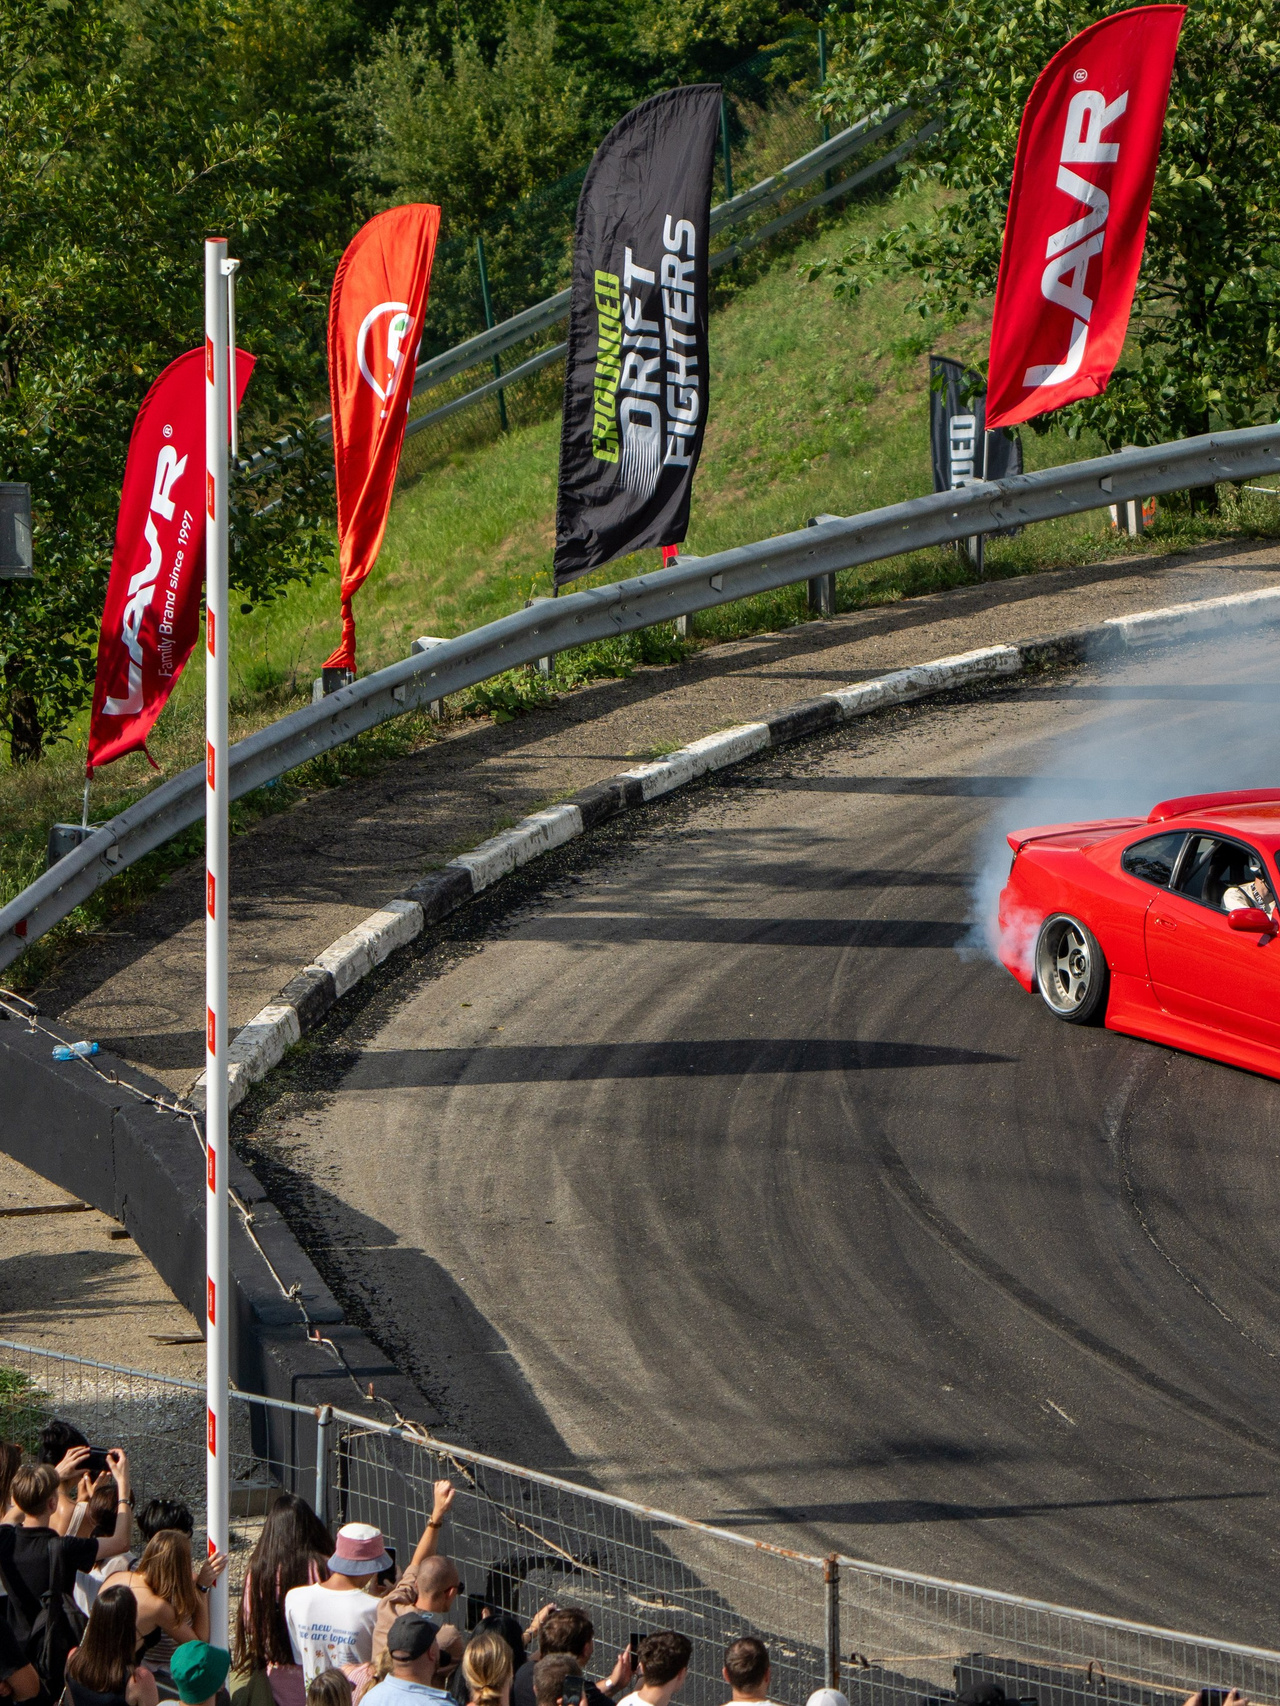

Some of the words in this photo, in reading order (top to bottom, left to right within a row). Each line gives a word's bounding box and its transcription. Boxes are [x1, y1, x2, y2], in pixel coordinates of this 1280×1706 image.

[1024, 89, 1129, 388] LAVR
[662, 213, 698, 466] FIGHTERS
[592, 270, 621, 463] GROUNDED
[620, 246, 661, 497] DRIFT
[177, 510, 194, 546] 1997
[102, 445, 189, 715] LAVR
[169, 550, 184, 590] since
[159, 590, 176, 635] Brand
[157, 637, 176, 677] Family
[311, 1623, 332, 1632] new
[311, 1633, 328, 1641] are
